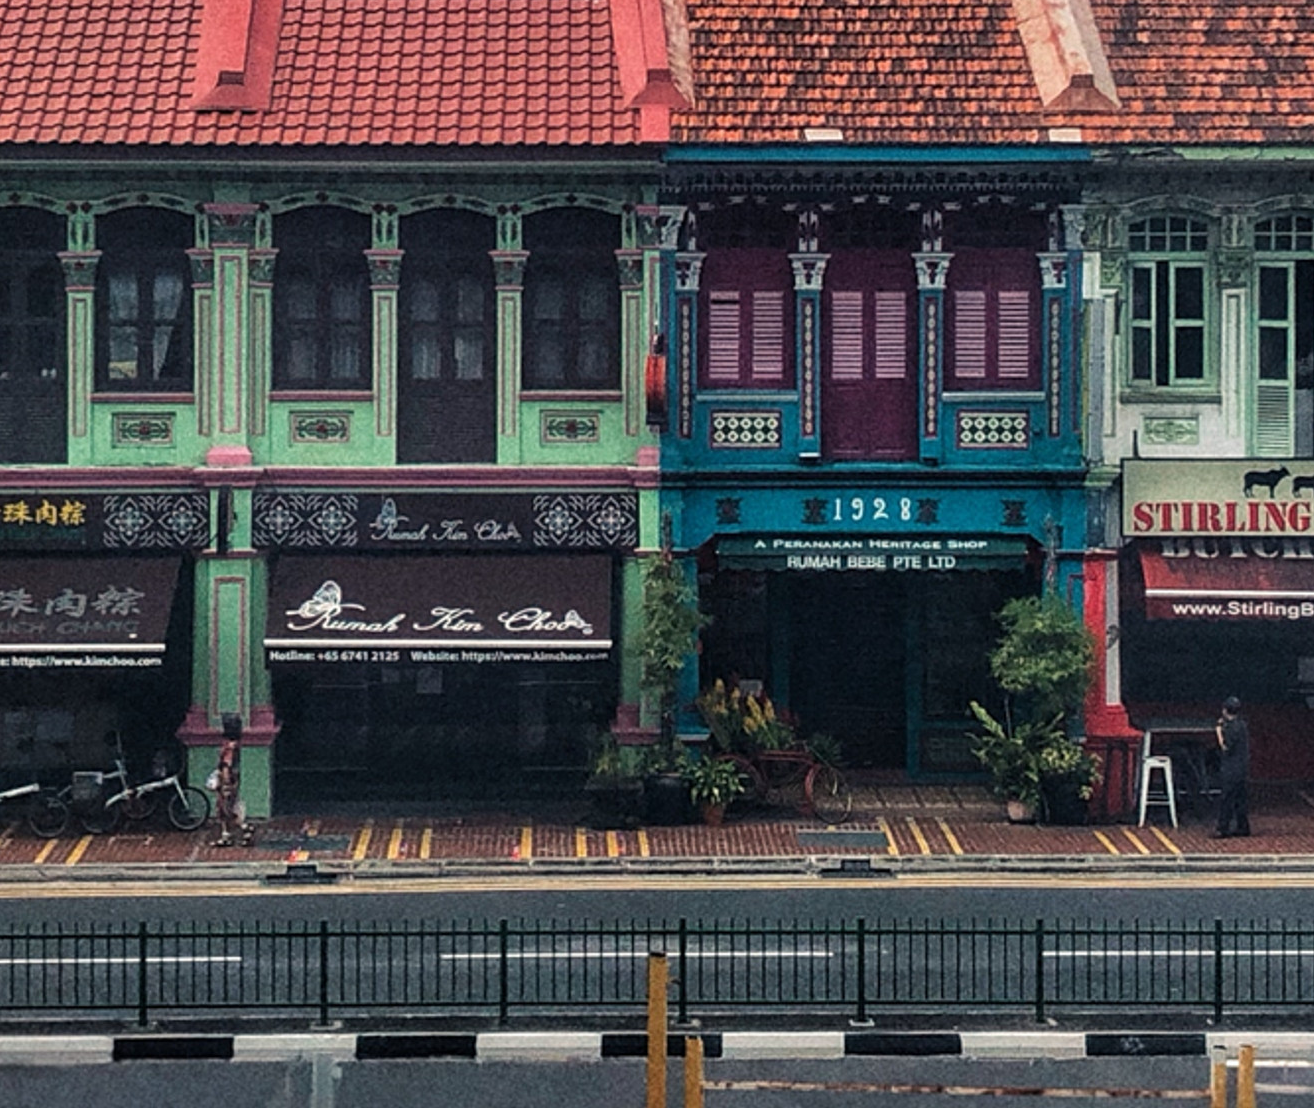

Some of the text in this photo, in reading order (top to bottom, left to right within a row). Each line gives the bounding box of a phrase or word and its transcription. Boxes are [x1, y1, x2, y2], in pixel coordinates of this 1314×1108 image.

[833, 497, 912, 521] 1928
[1133, 501, 1311, 533] STIRLING
[754, 540, 988, 550] A PERANAKAN HERITAGE SHOP
[787, 555, 956, 569] RUMAH BEBE PTE LTD
[287, 605, 576, 633] Rumah Kim Choo
[11, 655, 163, 669] https://www.kimchoo.com
[269, 650, 609, 663] Hotline: +65 6741 2125 Website: https://www.kimchoo.com
